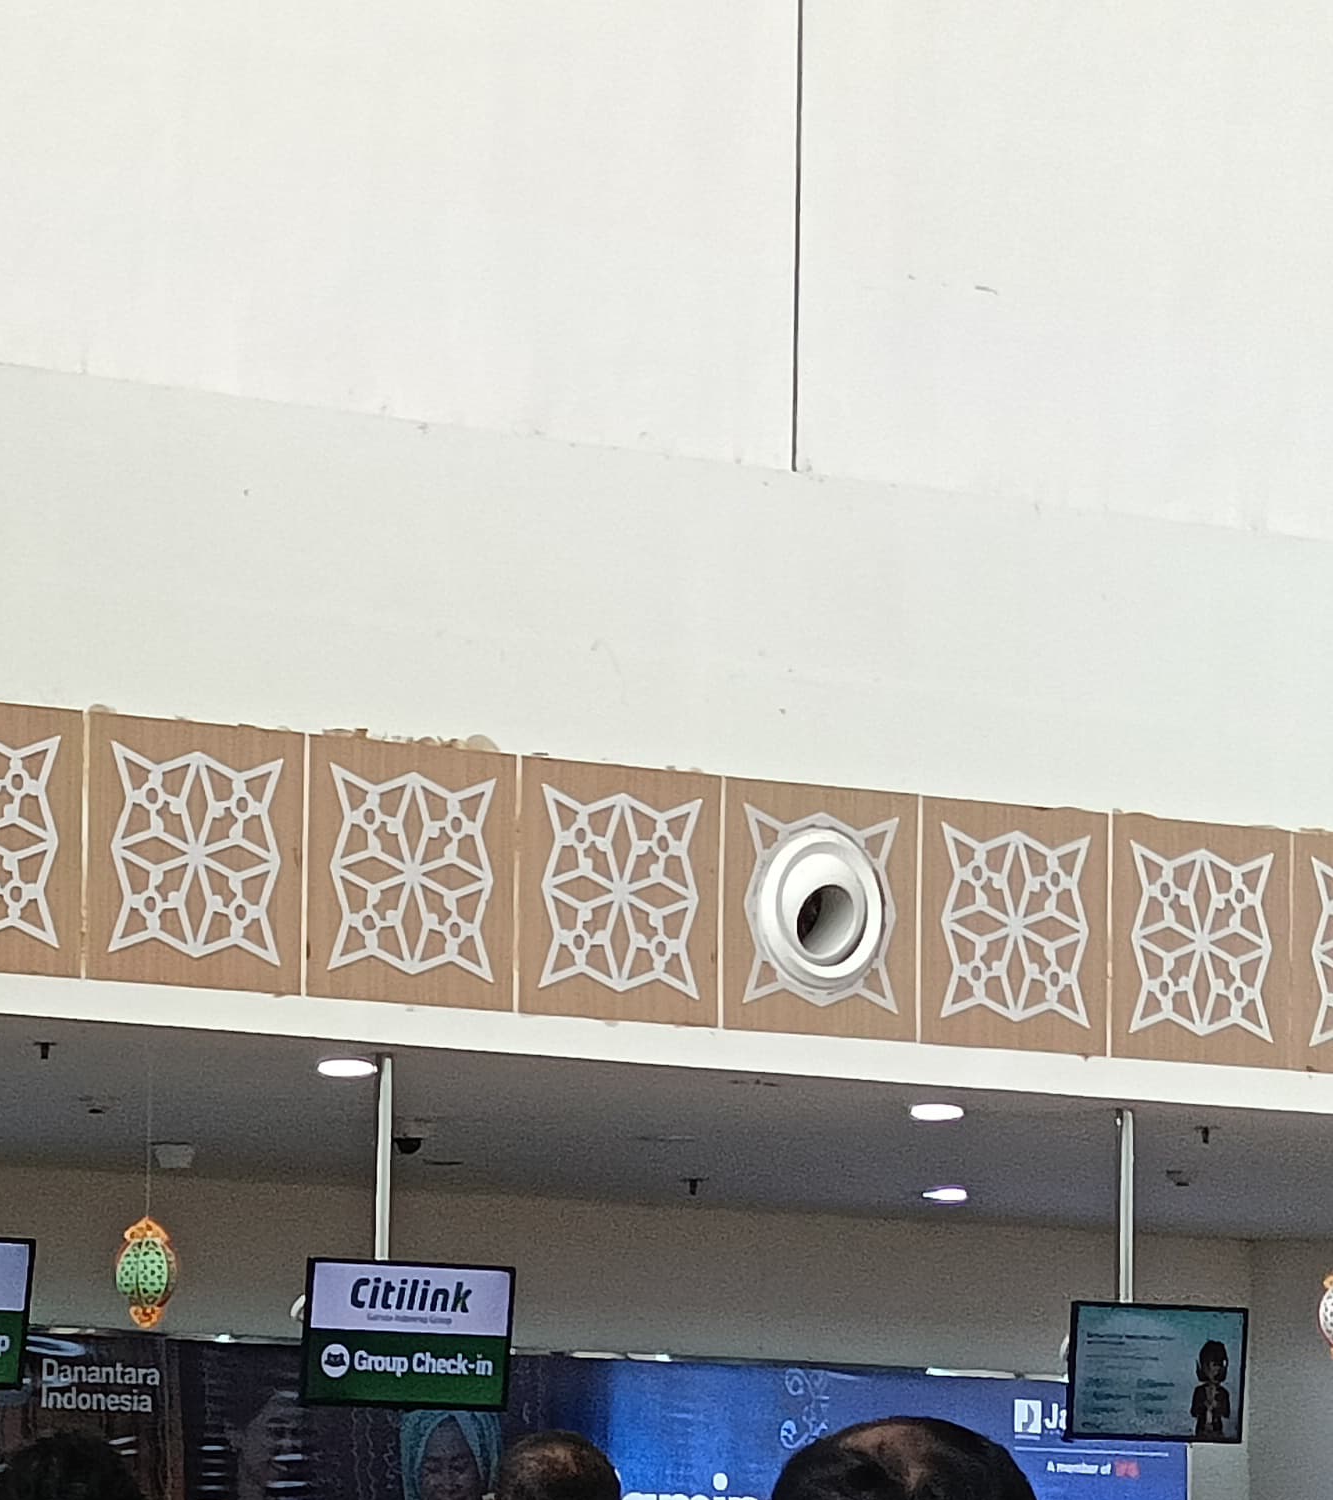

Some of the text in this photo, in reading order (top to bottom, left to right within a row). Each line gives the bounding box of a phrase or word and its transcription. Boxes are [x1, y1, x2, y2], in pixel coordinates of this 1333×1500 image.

[349, 1276, 473, 1314] Citilink
[41, 1358, 161, 1387] Danantara
[353, 1350, 493, 1378] Group Check-in
[41, 1386, 154, 1413] Indonesia
